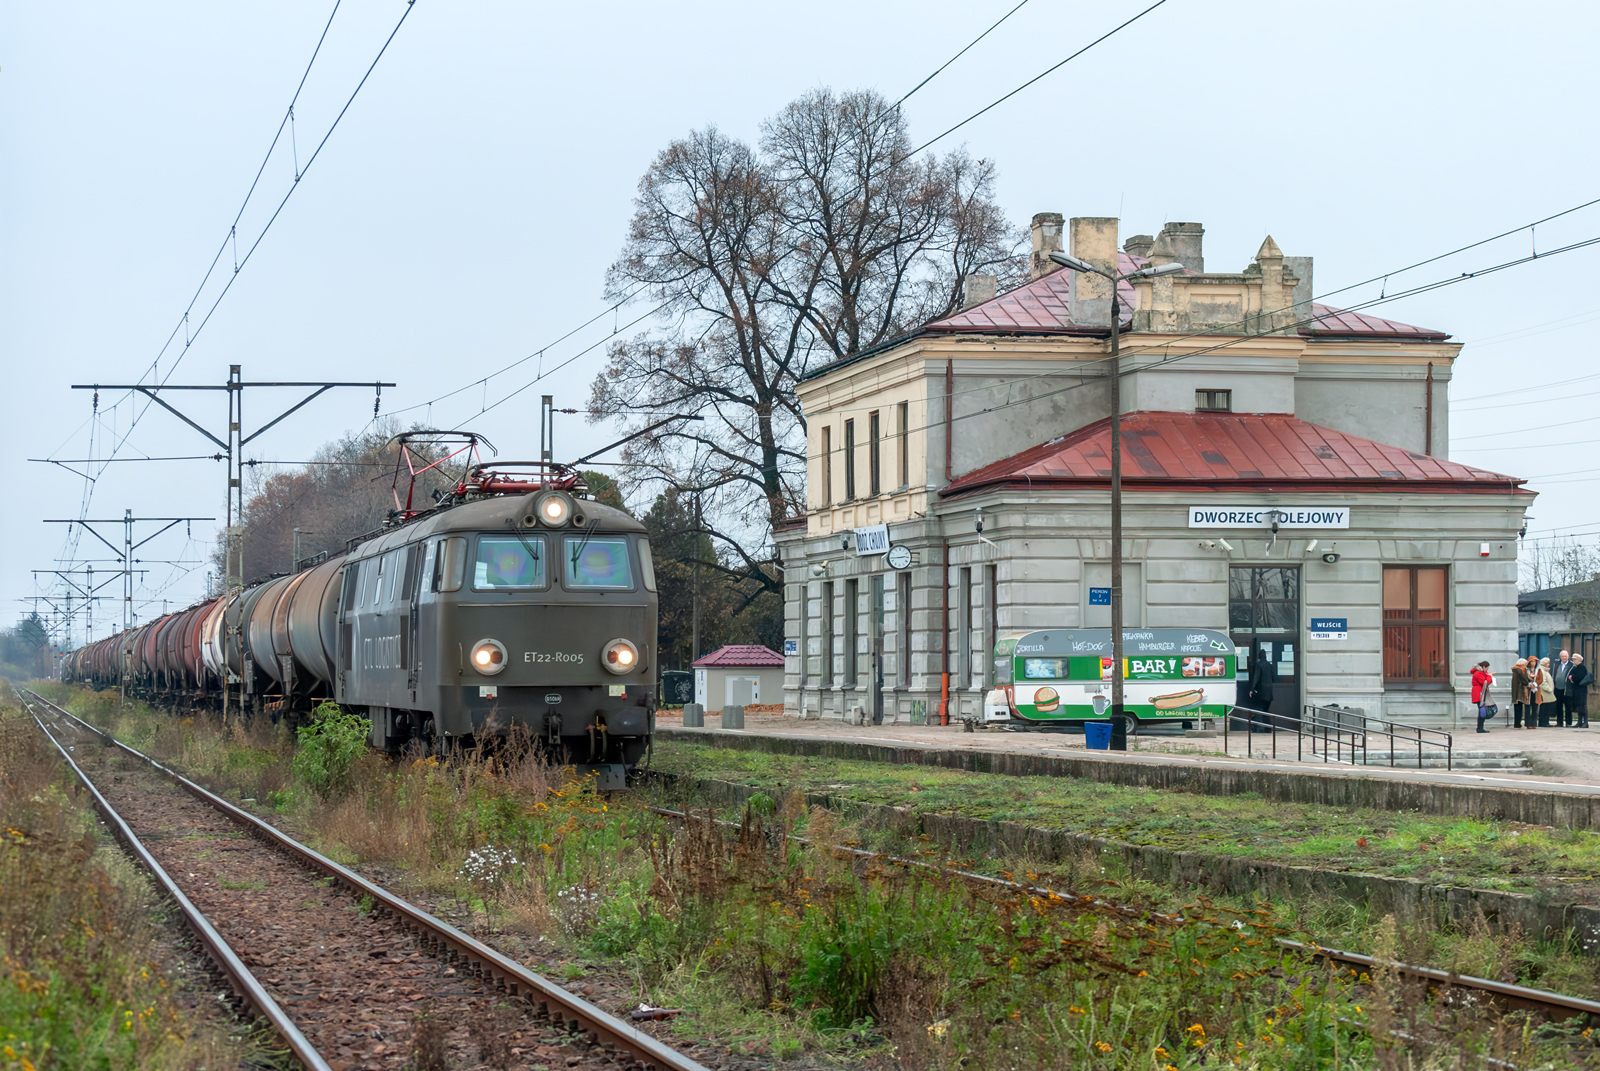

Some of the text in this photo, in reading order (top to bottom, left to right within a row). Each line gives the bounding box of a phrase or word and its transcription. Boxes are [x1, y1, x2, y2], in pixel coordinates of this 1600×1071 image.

[1194, 511, 1344, 524] DWORZEC OLEJOWY
[1110, 632, 1154, 641] PIEKANKA
[1186, 633, 1208, 643] KEBAB
[1072, 641, 1107, 652] HOT-DOG
[1138, 642, 1176, 651] HAMBURGER
